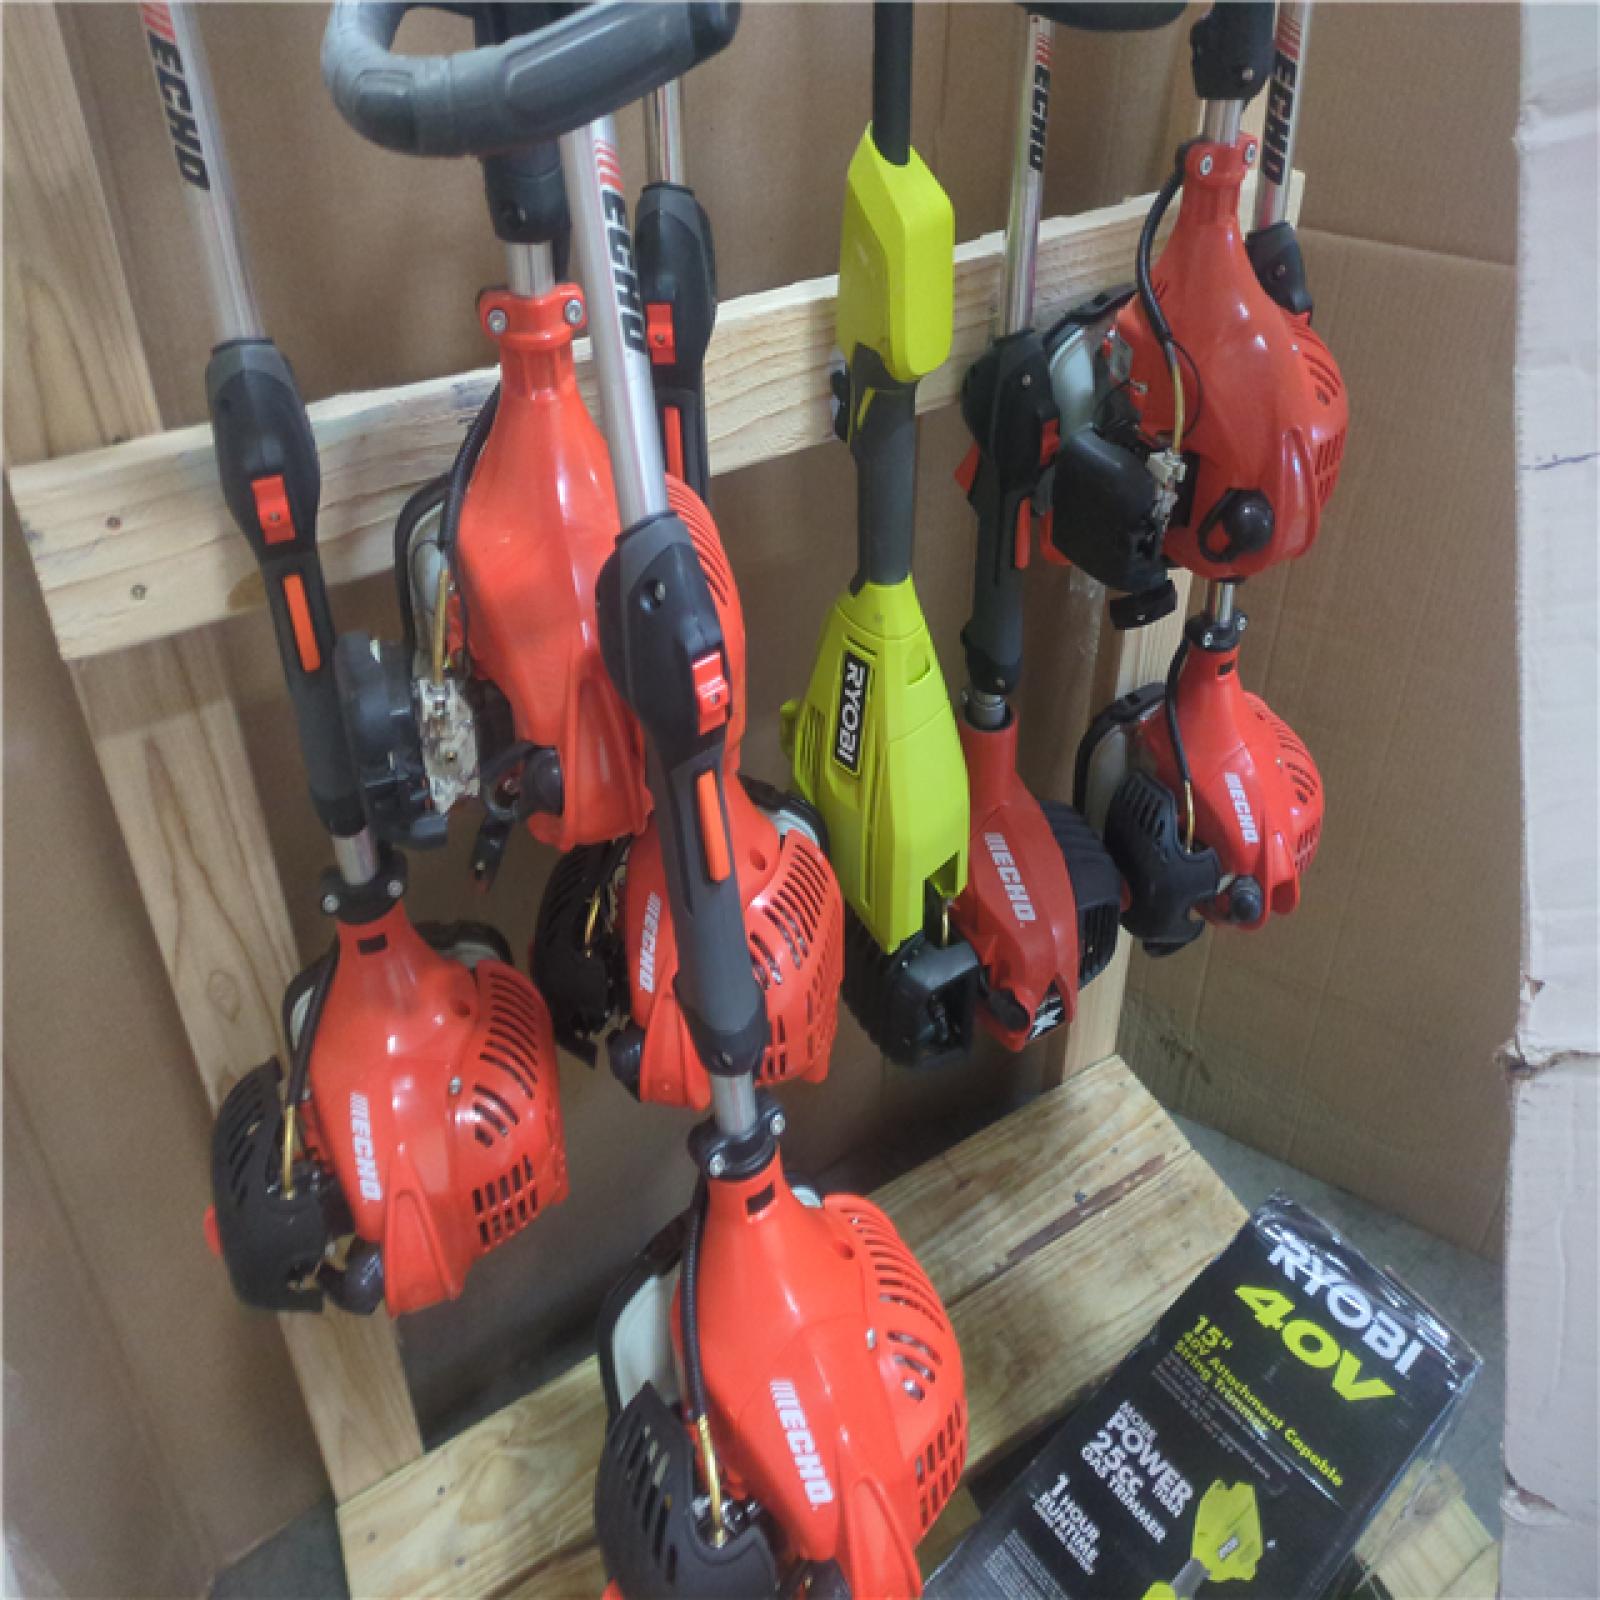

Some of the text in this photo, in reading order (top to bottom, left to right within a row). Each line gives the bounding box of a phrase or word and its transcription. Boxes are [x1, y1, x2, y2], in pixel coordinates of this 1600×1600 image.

[147, 29, 211, 191] ECHO
[1029, 63, 1051, 174] ECHO
[1262, 50, 1298, 186] ECHO
[601, 189, 647, 355] ECHO
[837, 661, 867, 764] RYOBI
[1227, 787, 1261, 845] ECHO
[990, 848, 1037, 922] ECHO
[639, 913, 661, 994] ECHO
[350, 1118, 384, 1202] ECHO
[1234, 1284, 1397, 1402] 40V
[1266, 1230, 1424, 1376] RYOBI
[1173, 1339, 1213, 1382] String
[778, 1409, 834, 1505] ECHO
[1105, 1411, 1194, 1508] POWER
[1206, 1356, 1285, 1431] Attachment
[1283, 1426, 1344, 1489] Capable
[1049, 1472, 1071, 1498] 1
[1060, 1494, 1101, 1541] HOUR
[1107, 1475, 1166, 1543] TRIMMER
